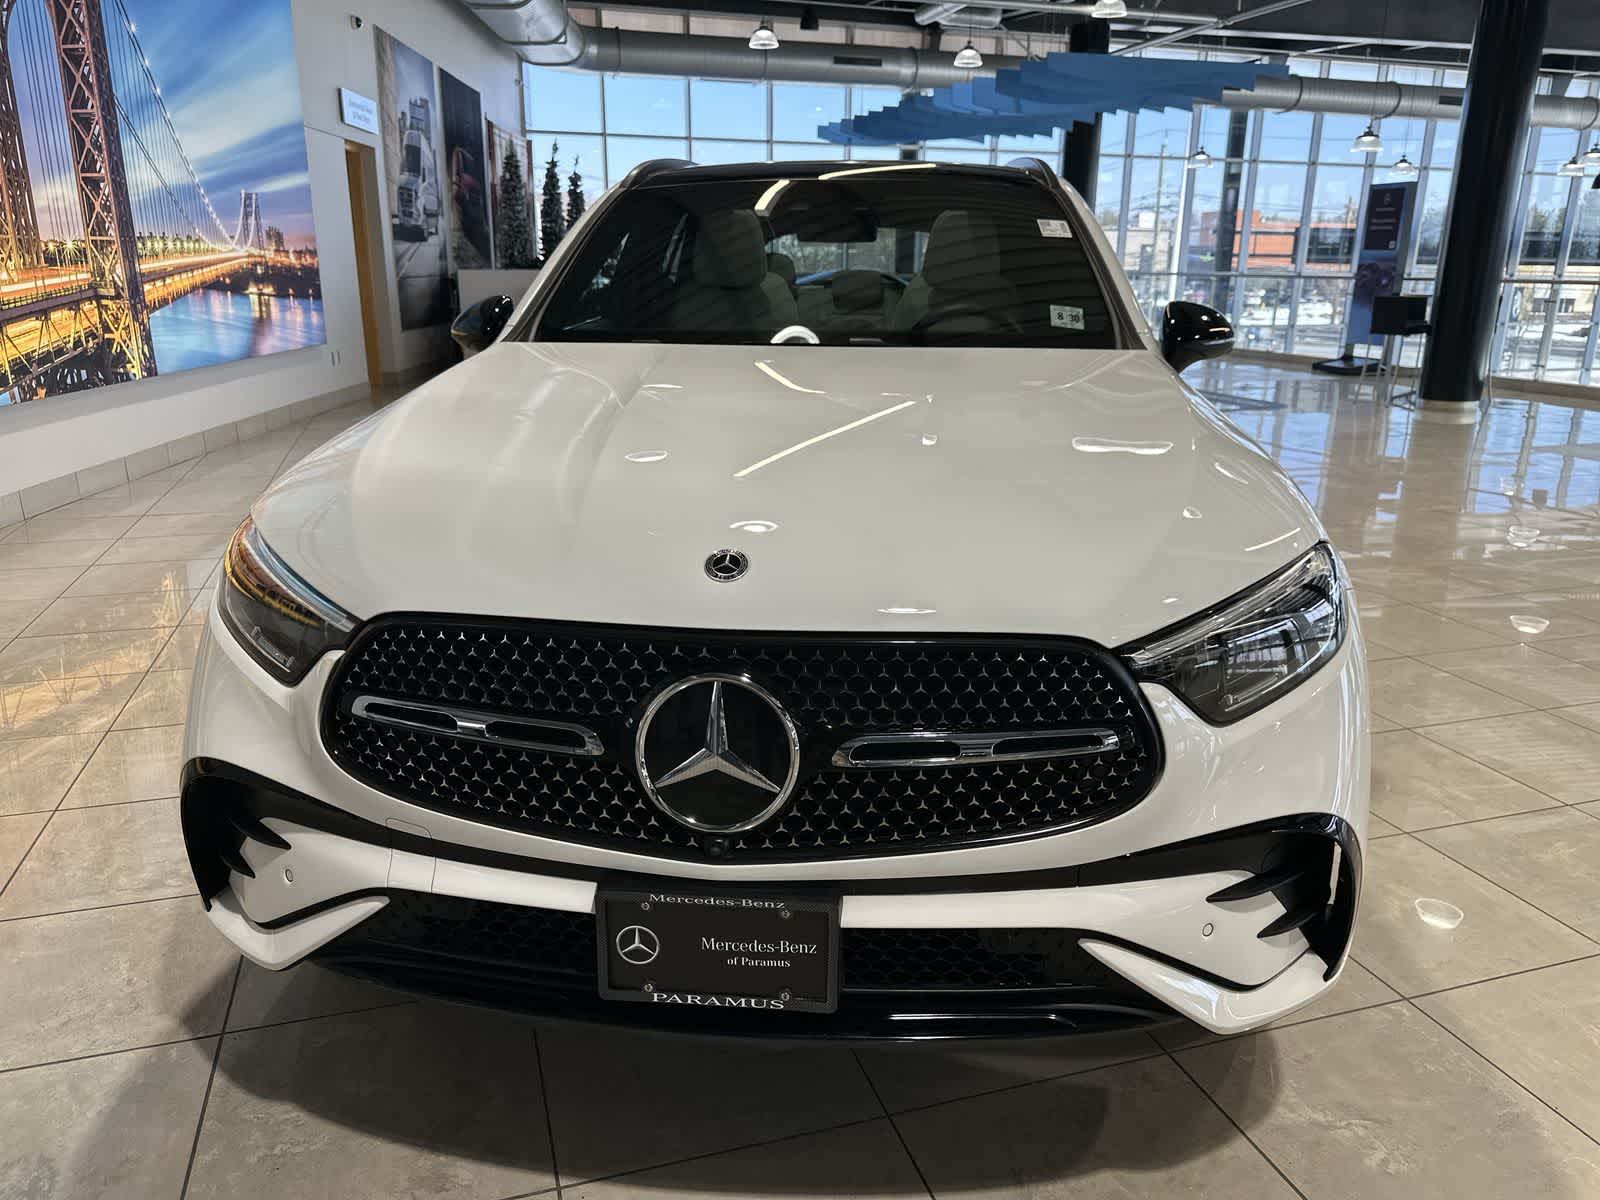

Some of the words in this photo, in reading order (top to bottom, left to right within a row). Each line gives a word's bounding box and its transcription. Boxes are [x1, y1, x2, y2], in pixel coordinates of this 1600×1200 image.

[1057, 311, 1064, 321] 8
[649, 894, 785, 909] Mercedes-Benz
[701, 936, 817, 954] Mercedes-Benz
[727, 956, 739, 966] of
[741, 956, 791, 968] Paramus
[651, 992, 785, 1010] PARAMUS
